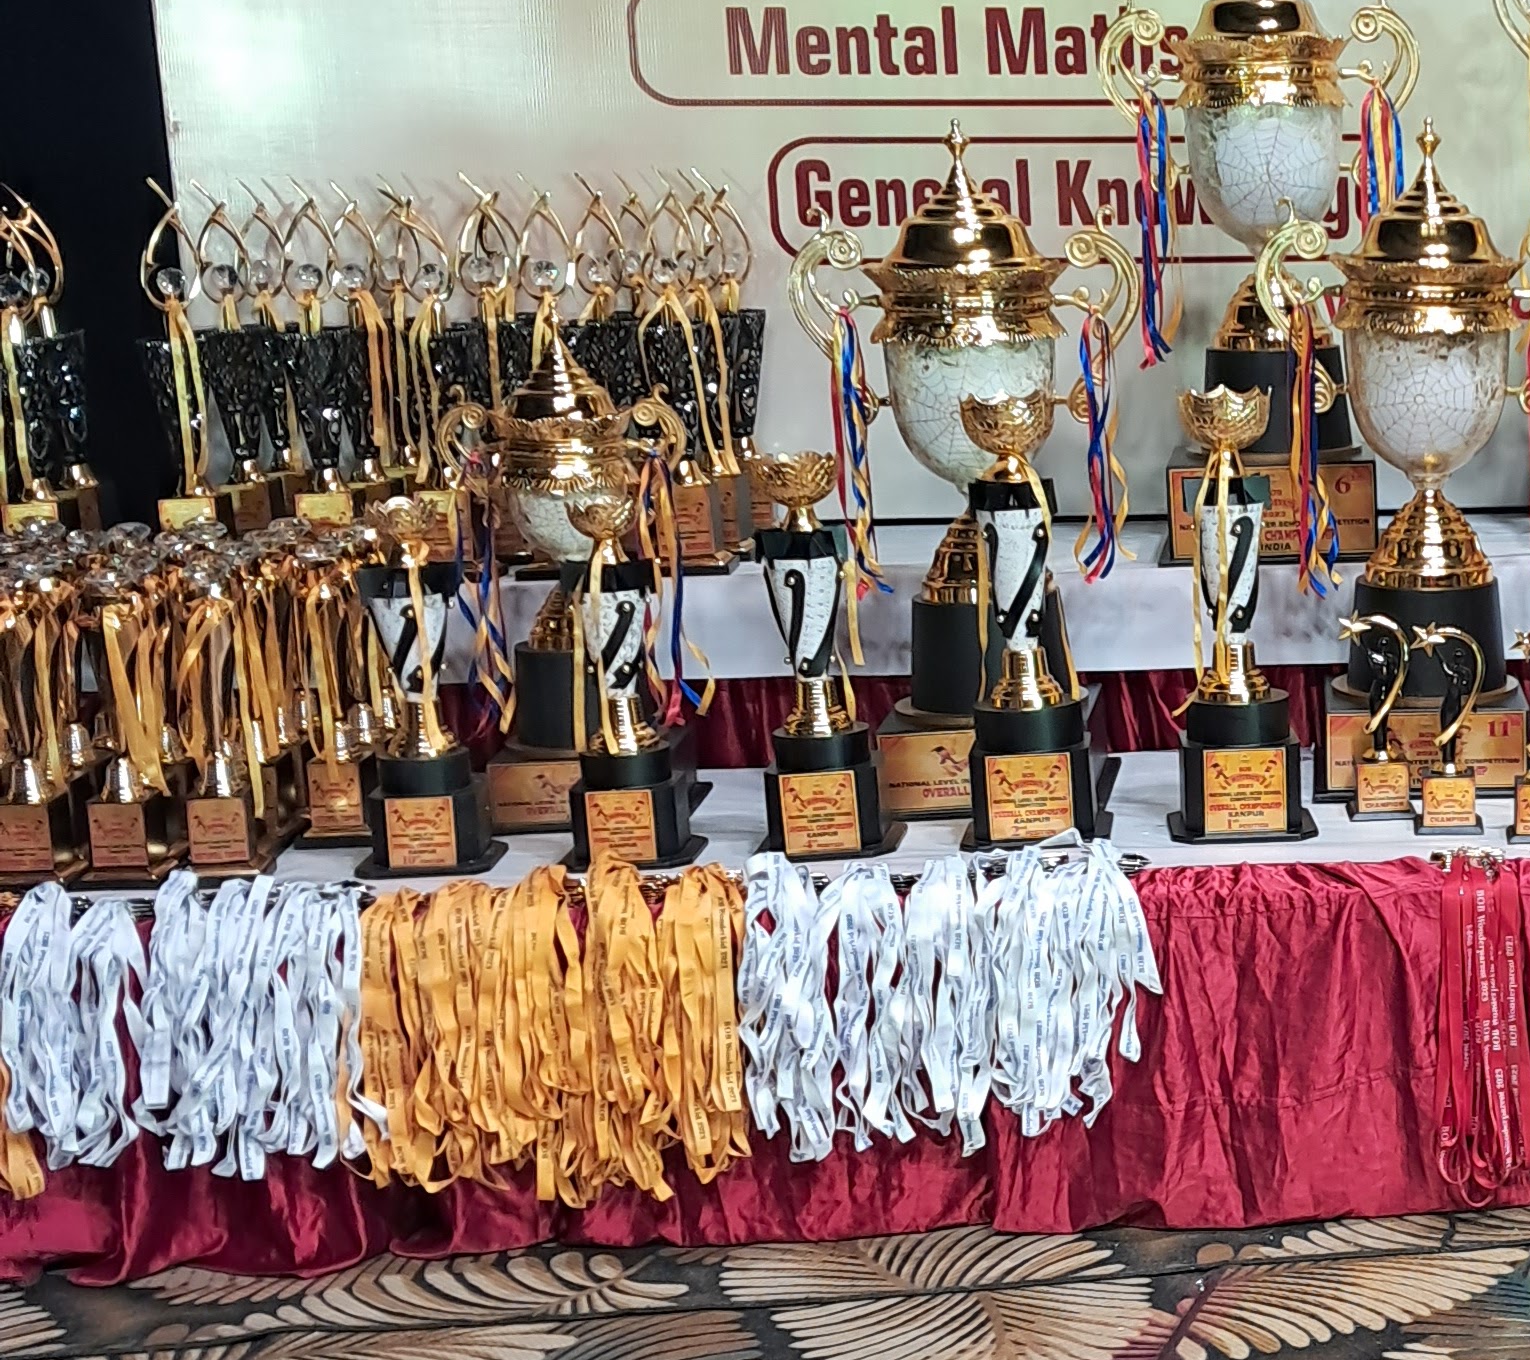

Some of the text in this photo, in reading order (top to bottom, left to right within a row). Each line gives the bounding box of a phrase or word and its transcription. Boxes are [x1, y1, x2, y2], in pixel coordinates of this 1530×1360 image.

[725, 6, 959, 76] Mental
[795, 158, 1031, 227] Geneal
[1261, 542, 1292, 551] INDIA
[1476, 889, 1486, 912] BOB
[1507, 1024, 1519, 1047] BOB
